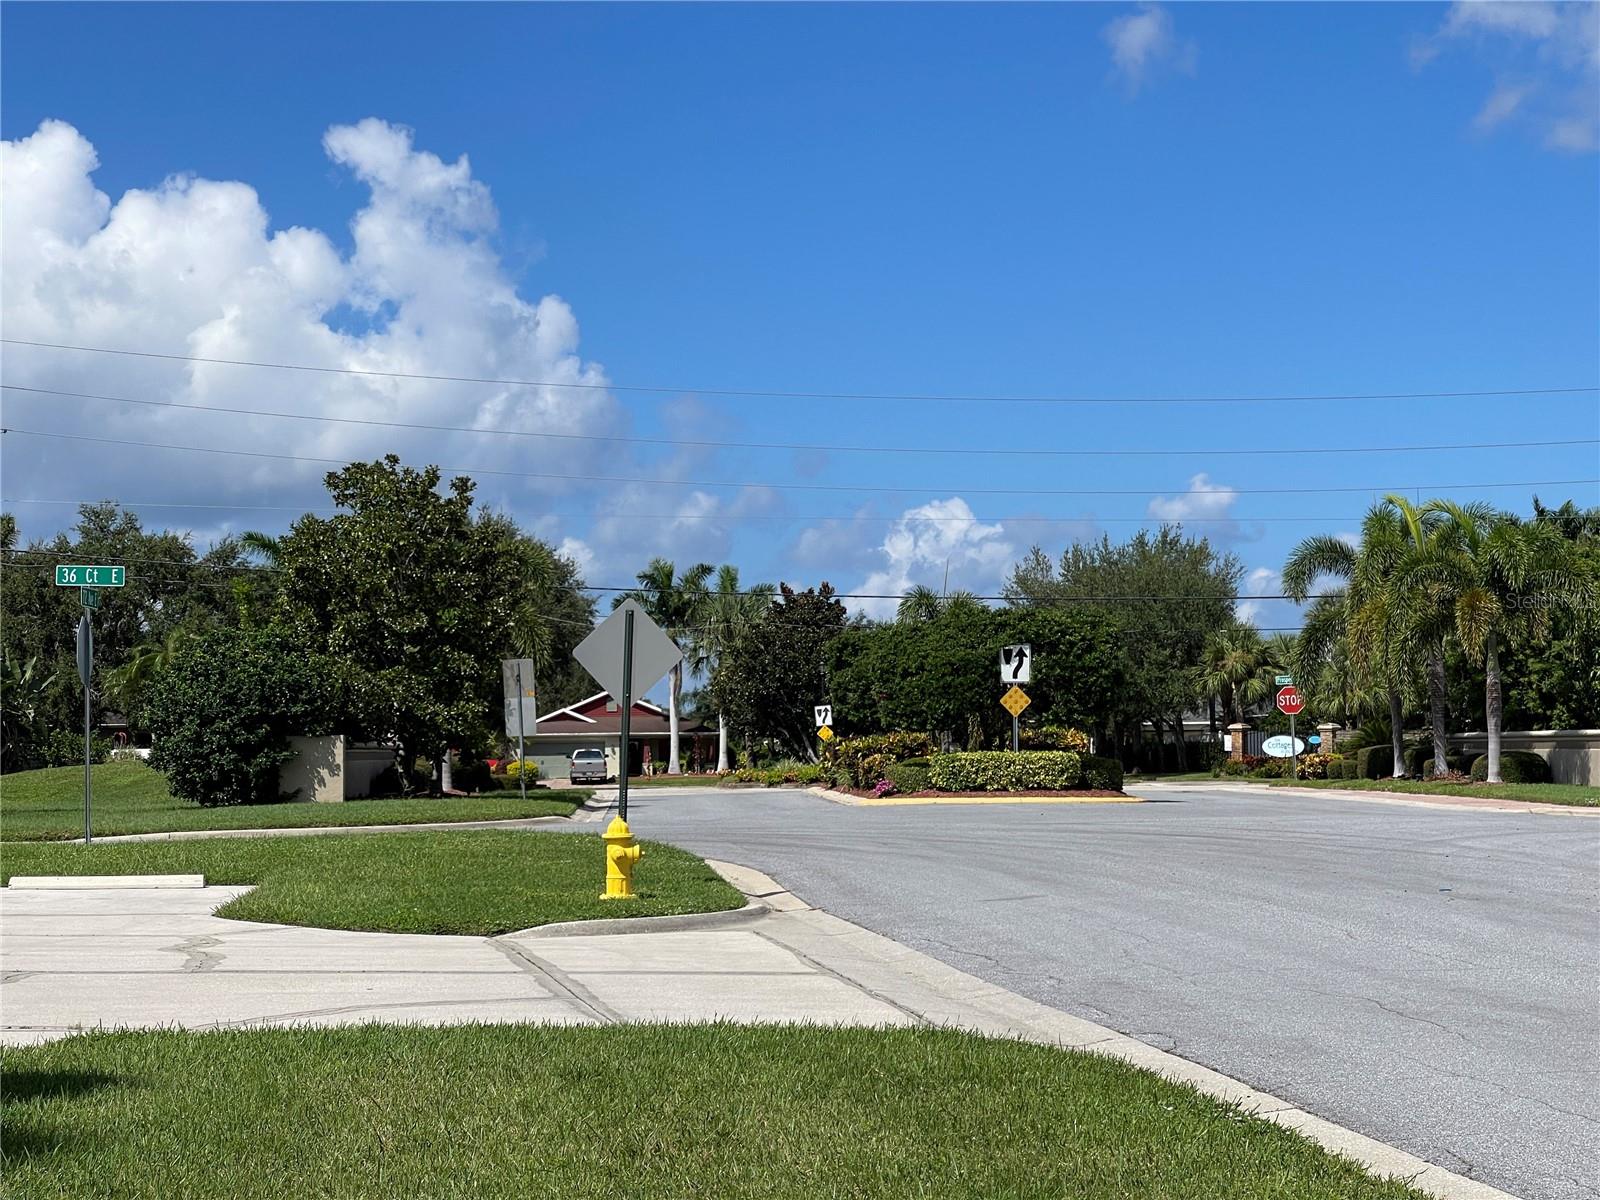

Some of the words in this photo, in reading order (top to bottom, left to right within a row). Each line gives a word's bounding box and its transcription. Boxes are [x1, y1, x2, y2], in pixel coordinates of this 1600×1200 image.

[62, 568, 76, 582] 36
[86, 569, 98, 583] Ct
[112, 569, 118, 583] E
